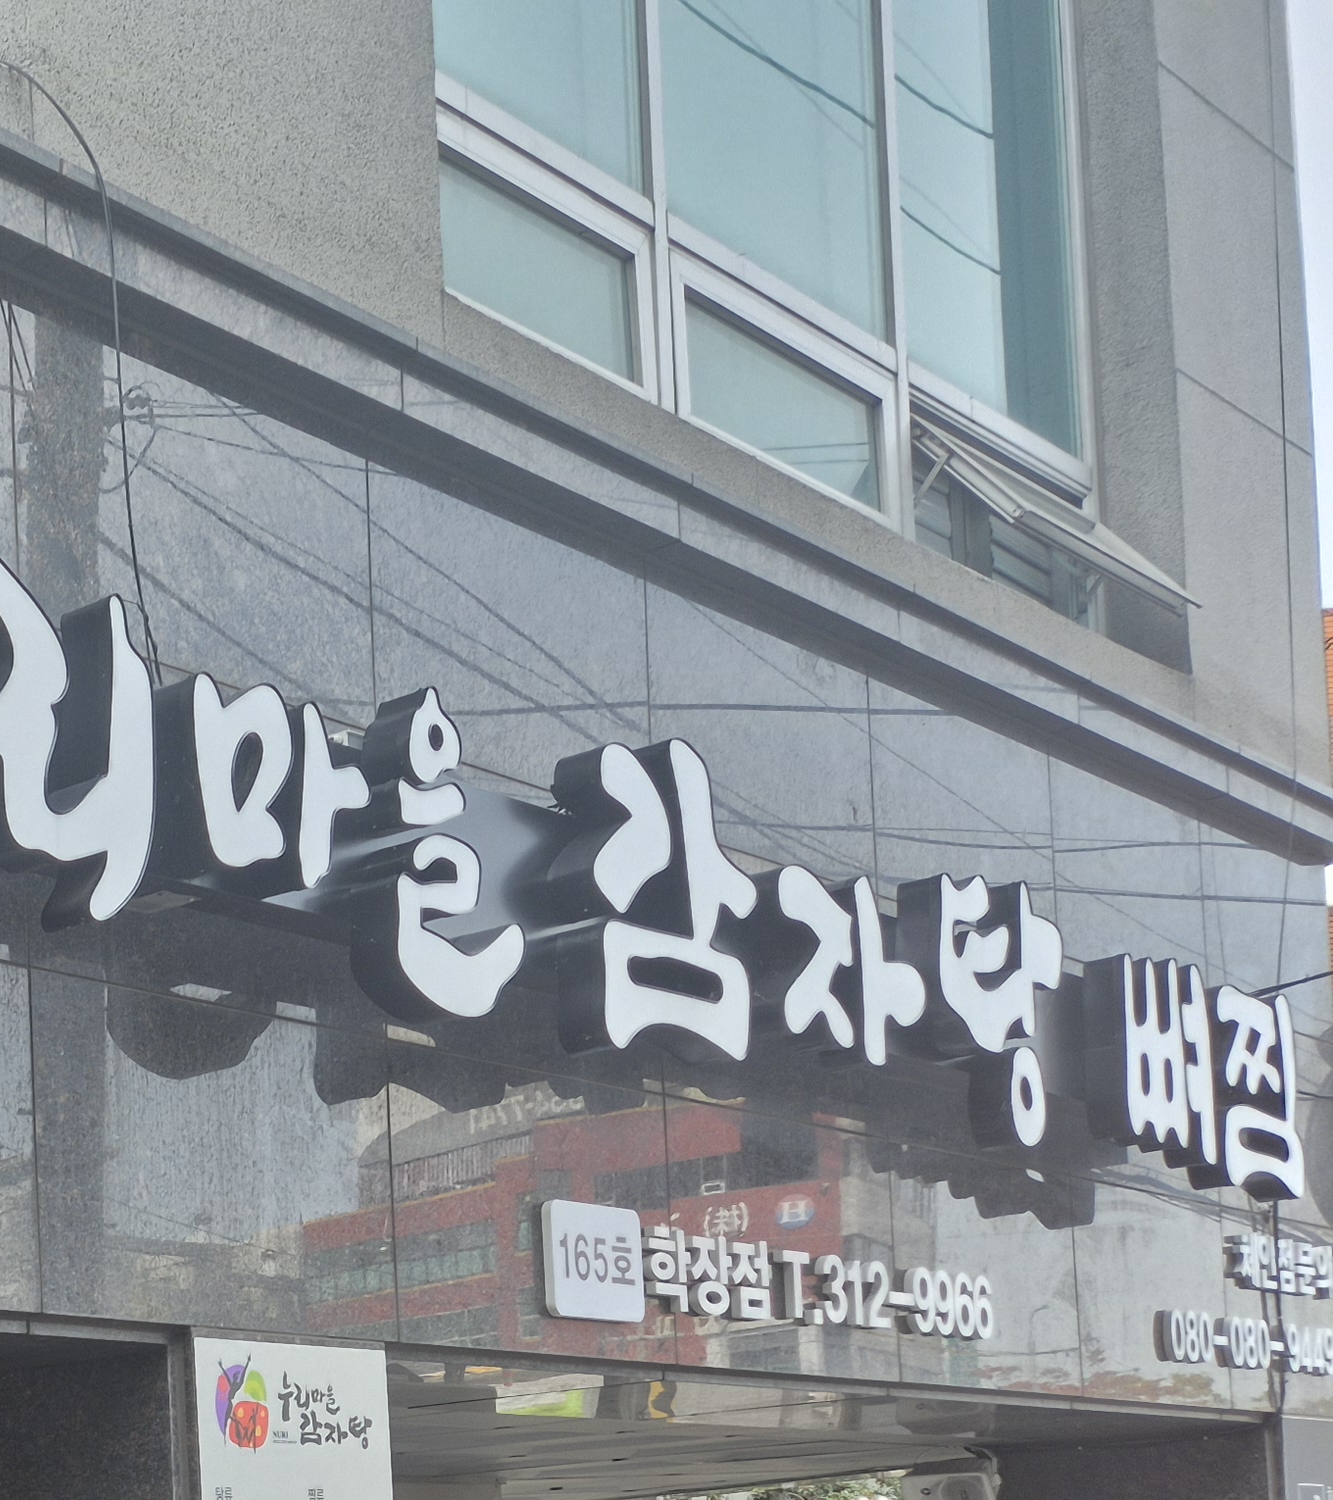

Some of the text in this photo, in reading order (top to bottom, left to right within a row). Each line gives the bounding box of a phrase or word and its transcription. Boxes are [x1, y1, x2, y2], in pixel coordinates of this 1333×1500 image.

[592, 738, 1064, 1146] 감자탕
[1123, 952, 1305, 1199] 뼈찜
[558, 1232, 637, 1287] 165호
[645, 1225, 772, 1320] 학장점
[278, 1371, 341, 1421] 누리마을
[300, 1409, 373, 1450] 감자탕
